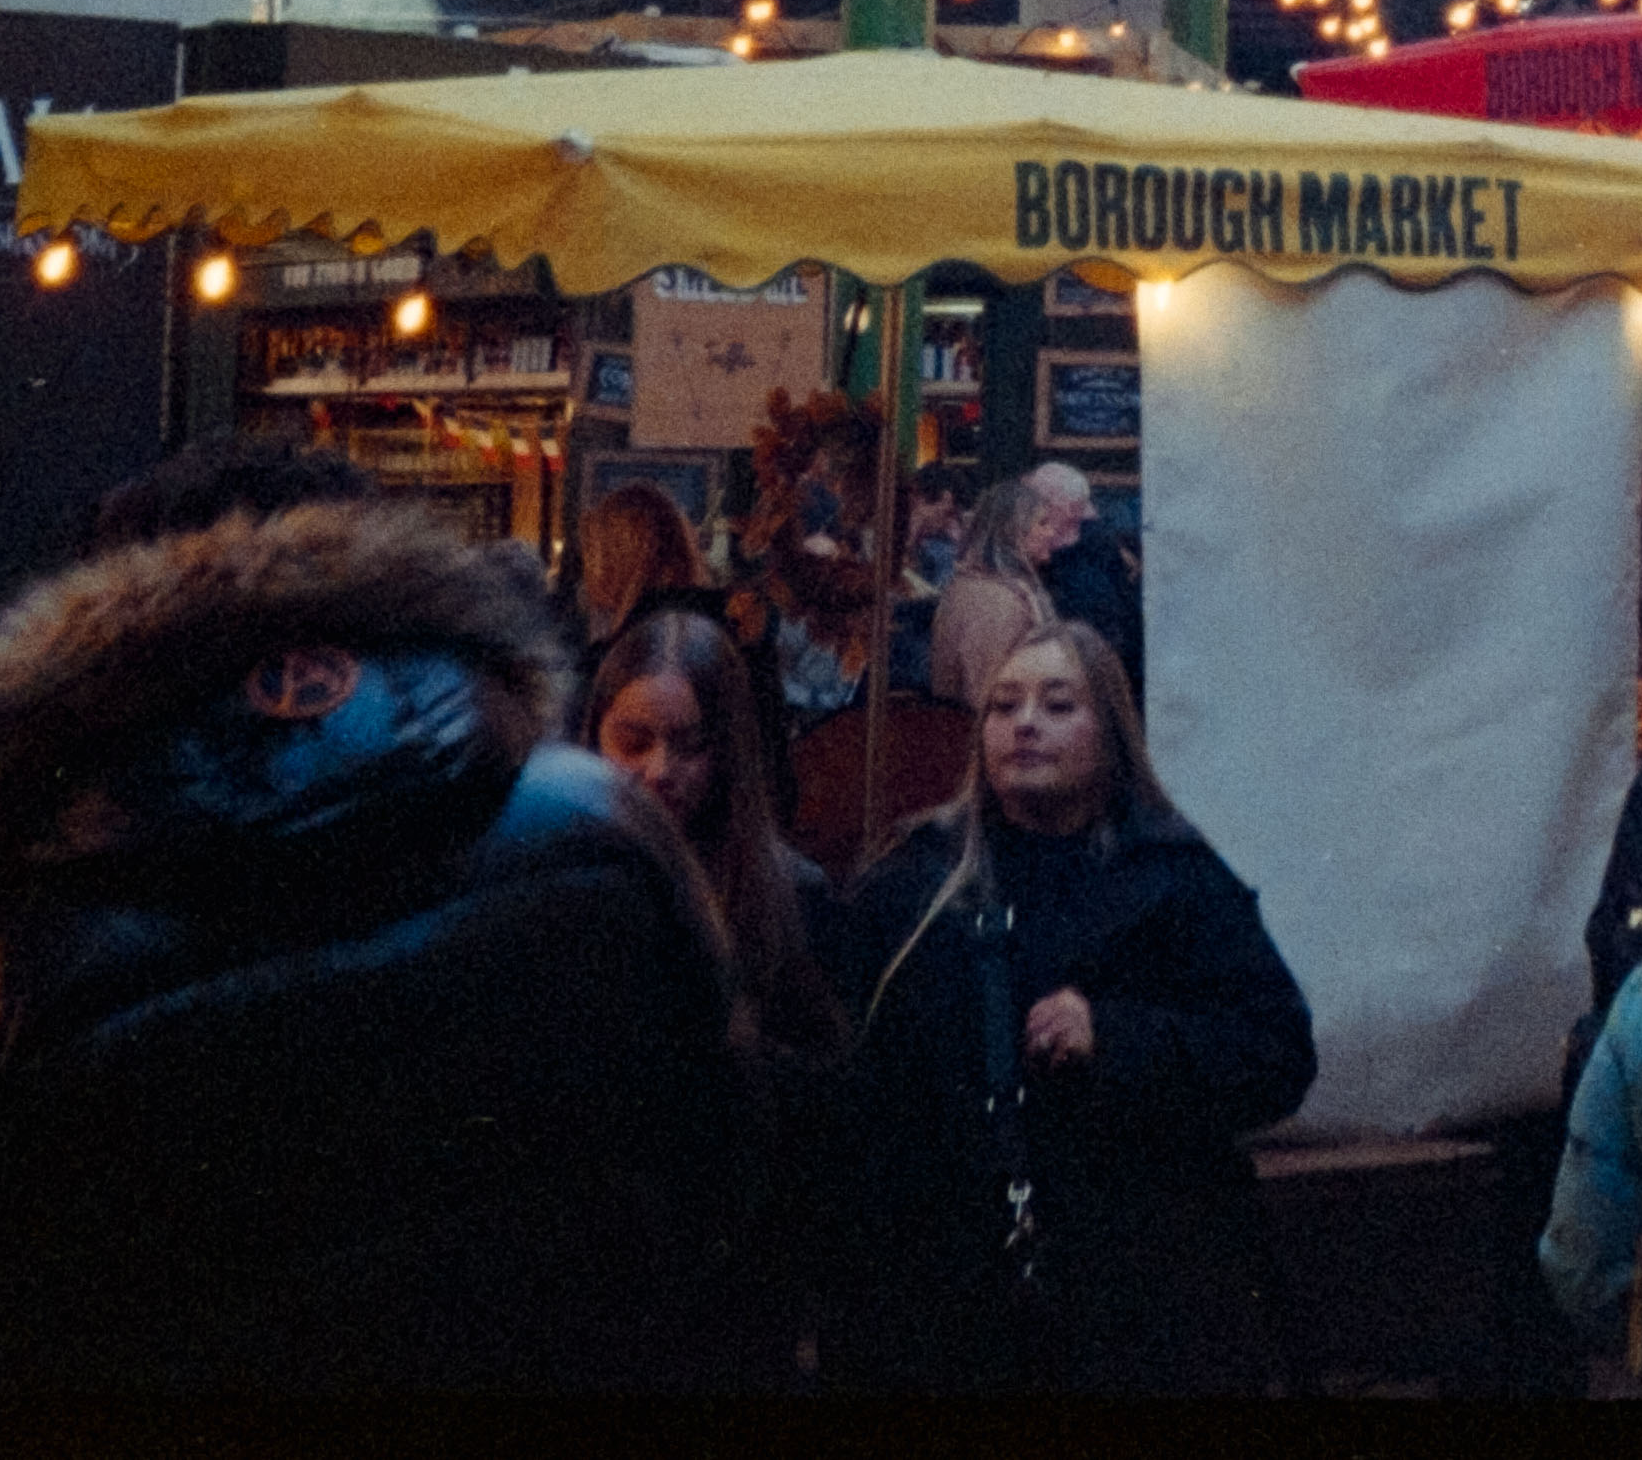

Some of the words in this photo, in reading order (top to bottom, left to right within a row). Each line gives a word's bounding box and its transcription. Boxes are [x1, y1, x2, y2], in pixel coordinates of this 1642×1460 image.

[1484, 37, 1622, 119] BOROUGH
[1014, 158, 1284, 253] BOROUGH
[1297, 169, 1523, 261] MARKET
